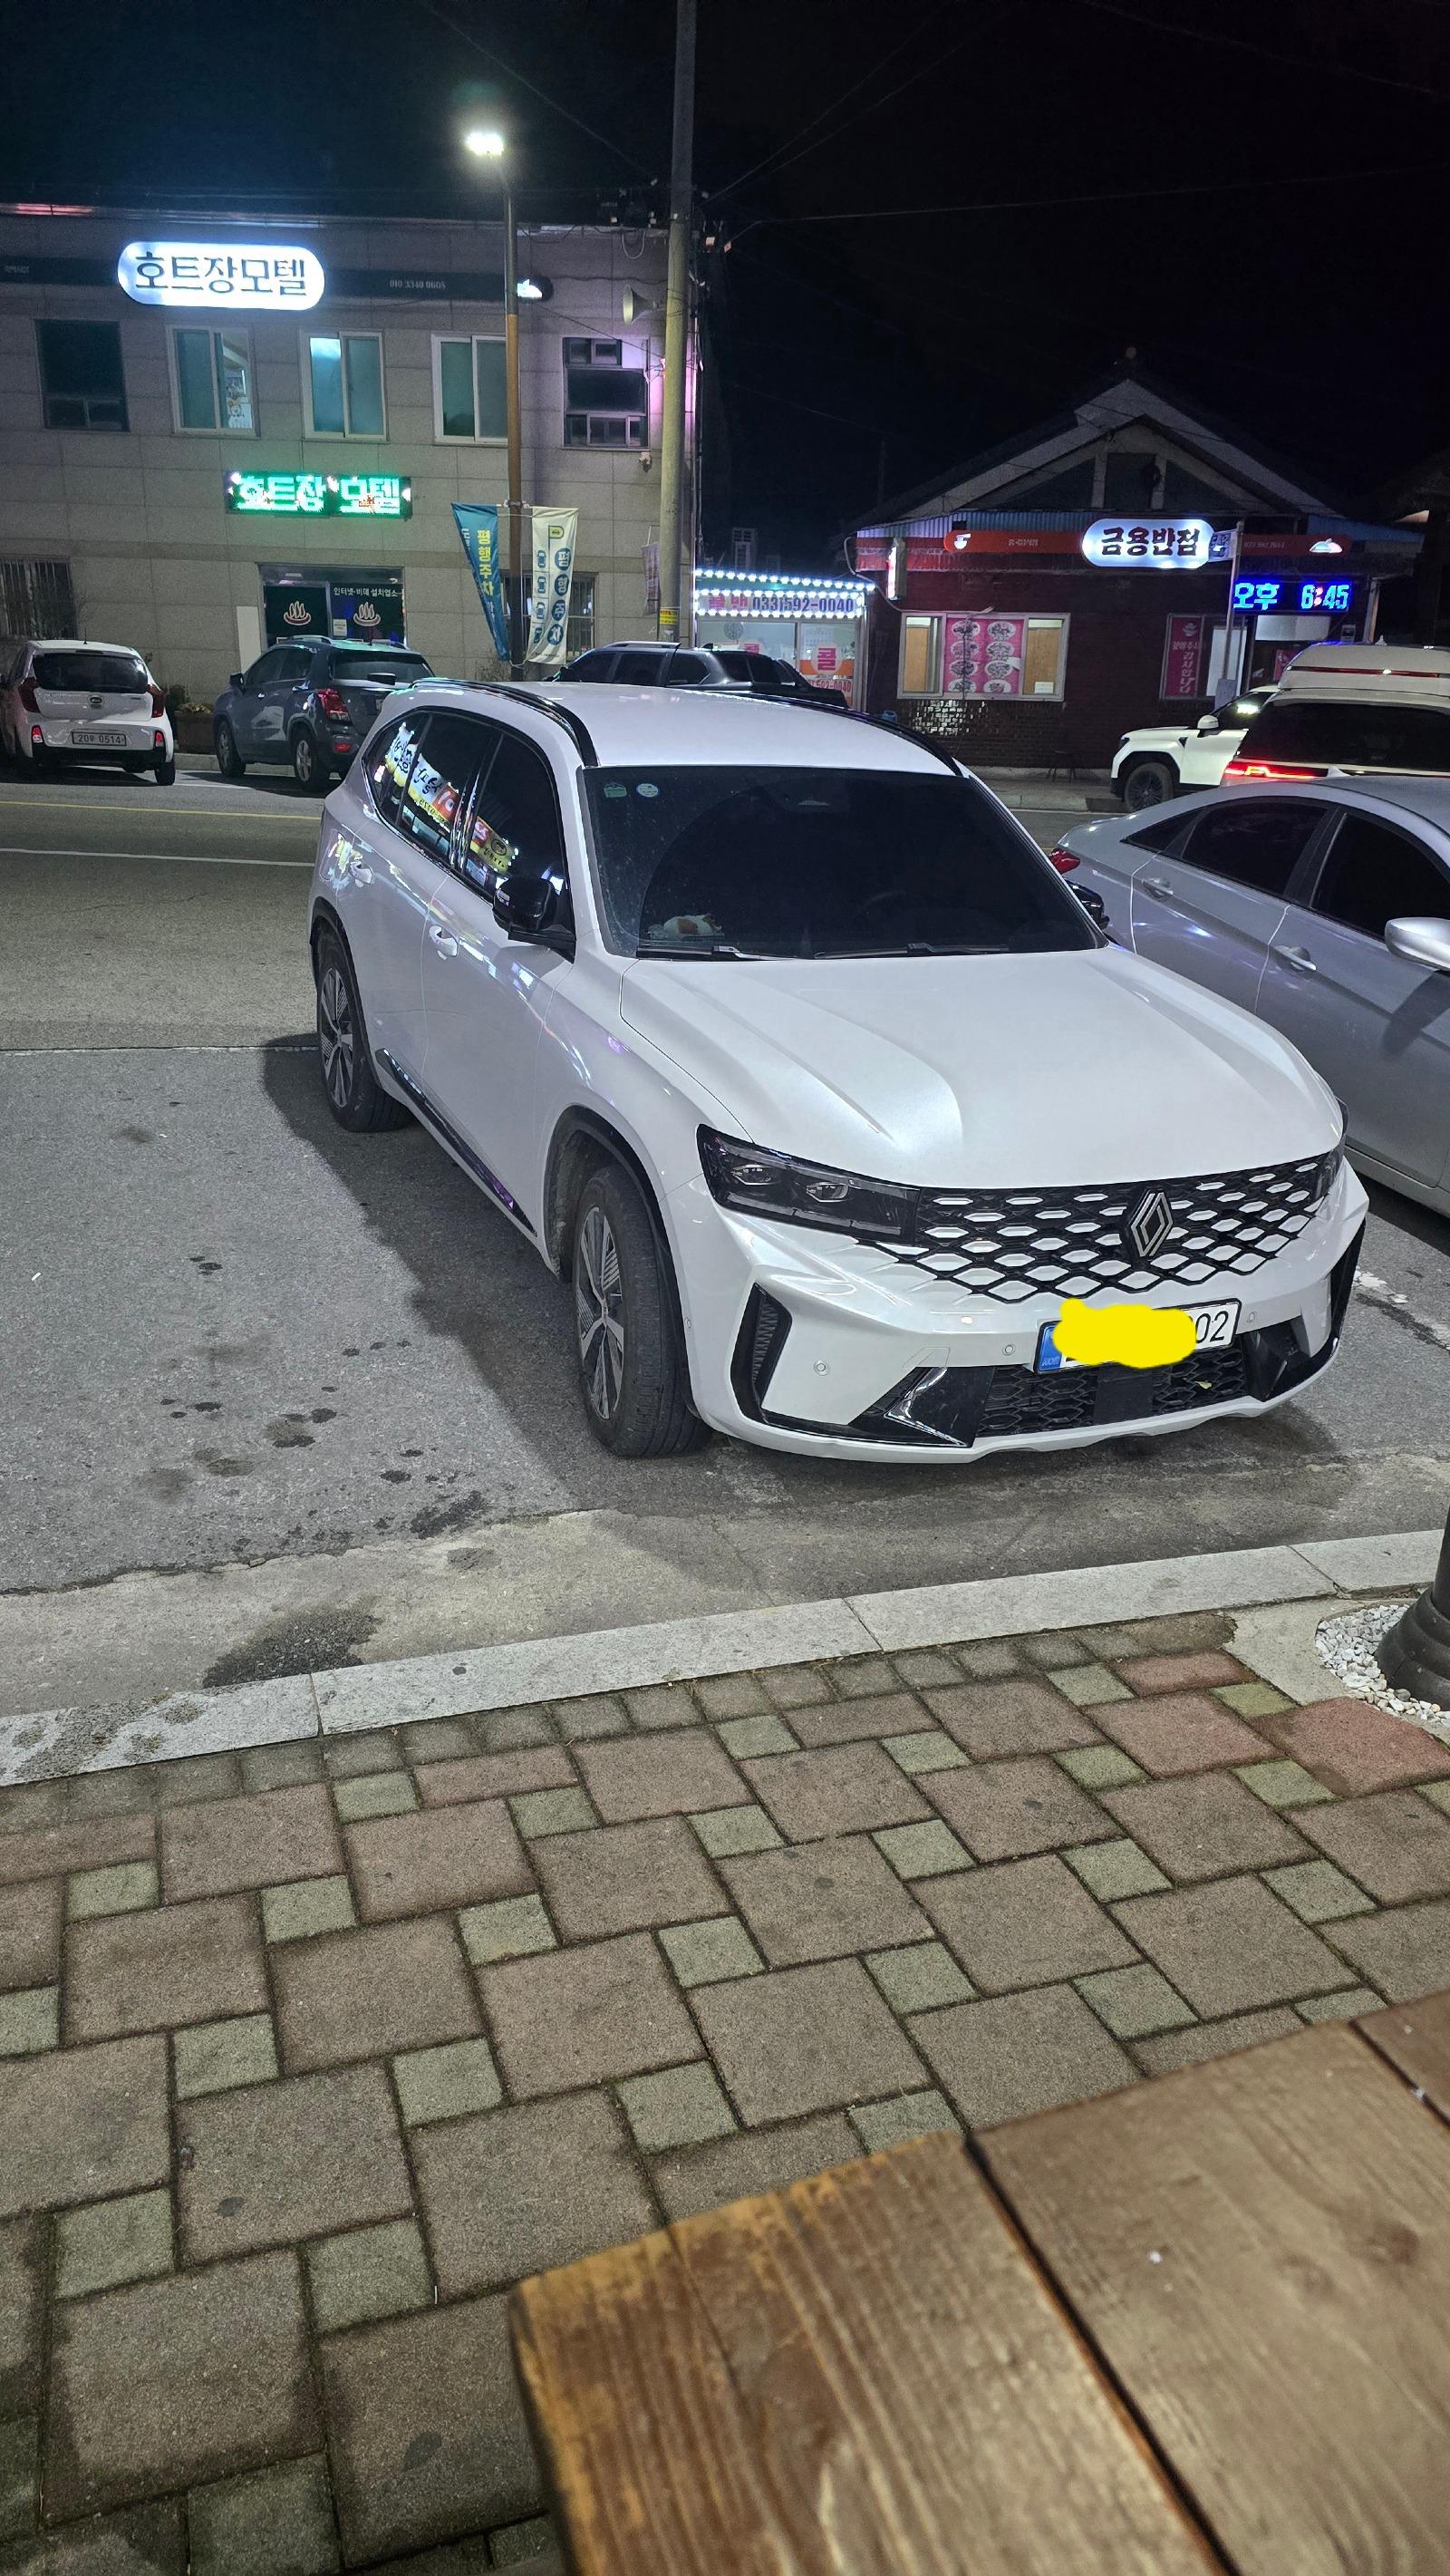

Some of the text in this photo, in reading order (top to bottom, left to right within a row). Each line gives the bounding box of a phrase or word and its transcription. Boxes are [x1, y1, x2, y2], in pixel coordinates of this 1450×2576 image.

[135, 250, 306, 296] 호트장모텔
[237, 475, 401, 516] 호트장 모텔
[1100, 526, 1201, 557] 금용반점
[477, 529, 495, 596] 평행주차
[1232, 582, 1350, 611] 오후 6:45
[817, 647, 836, 671] 콜
[99, 735, 121, 743] 0514
